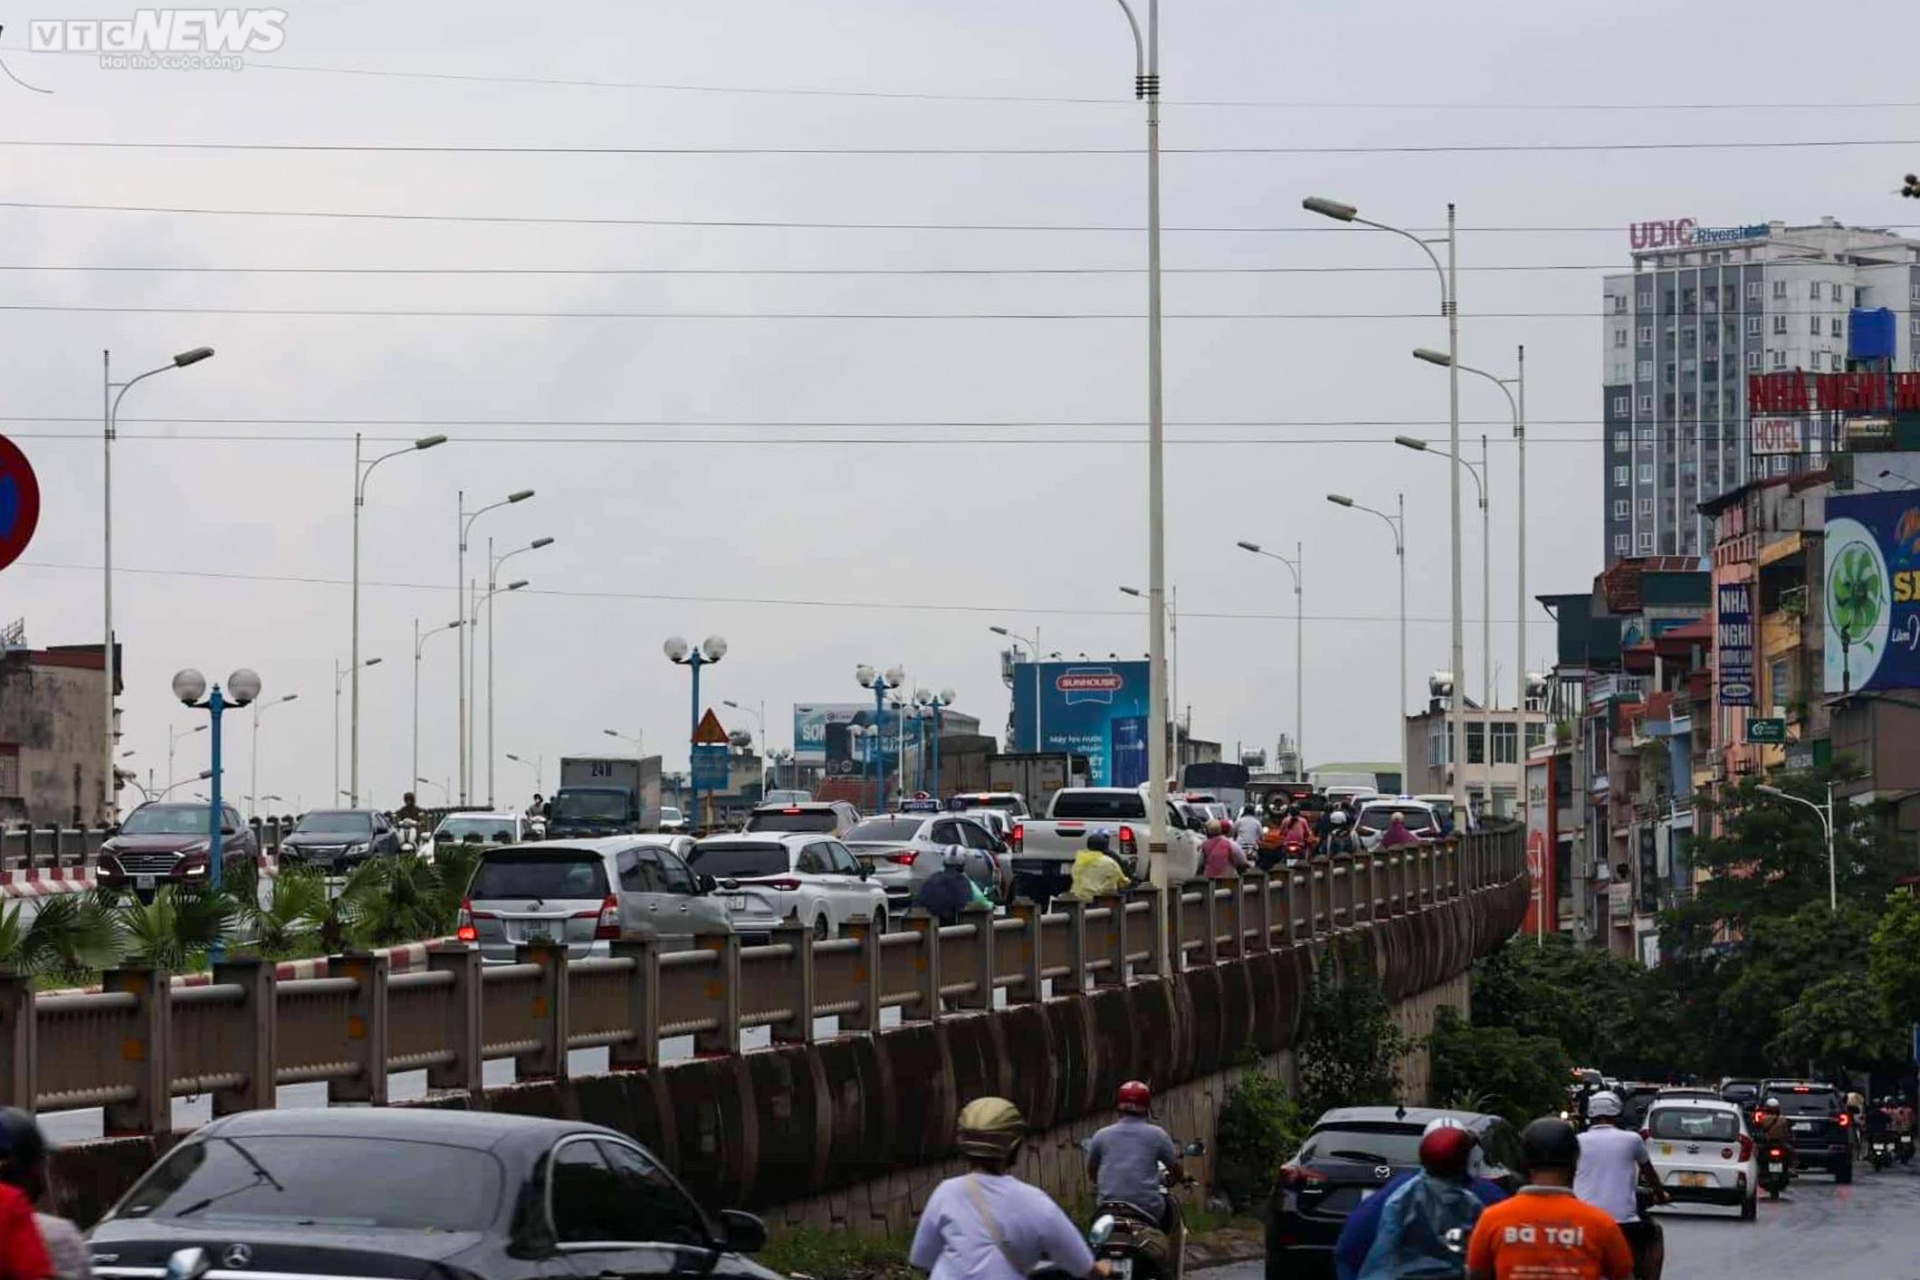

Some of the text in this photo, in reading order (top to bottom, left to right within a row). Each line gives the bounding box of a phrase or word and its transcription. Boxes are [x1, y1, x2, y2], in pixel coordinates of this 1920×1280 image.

[1630, 218, 1694, 248] UDIC
[1754, 420, 1799, 449] HOTEL
[1720, 586, 1750, 613] NHÀ
[1061, 678, 1117, 687] SUNHOUSE
